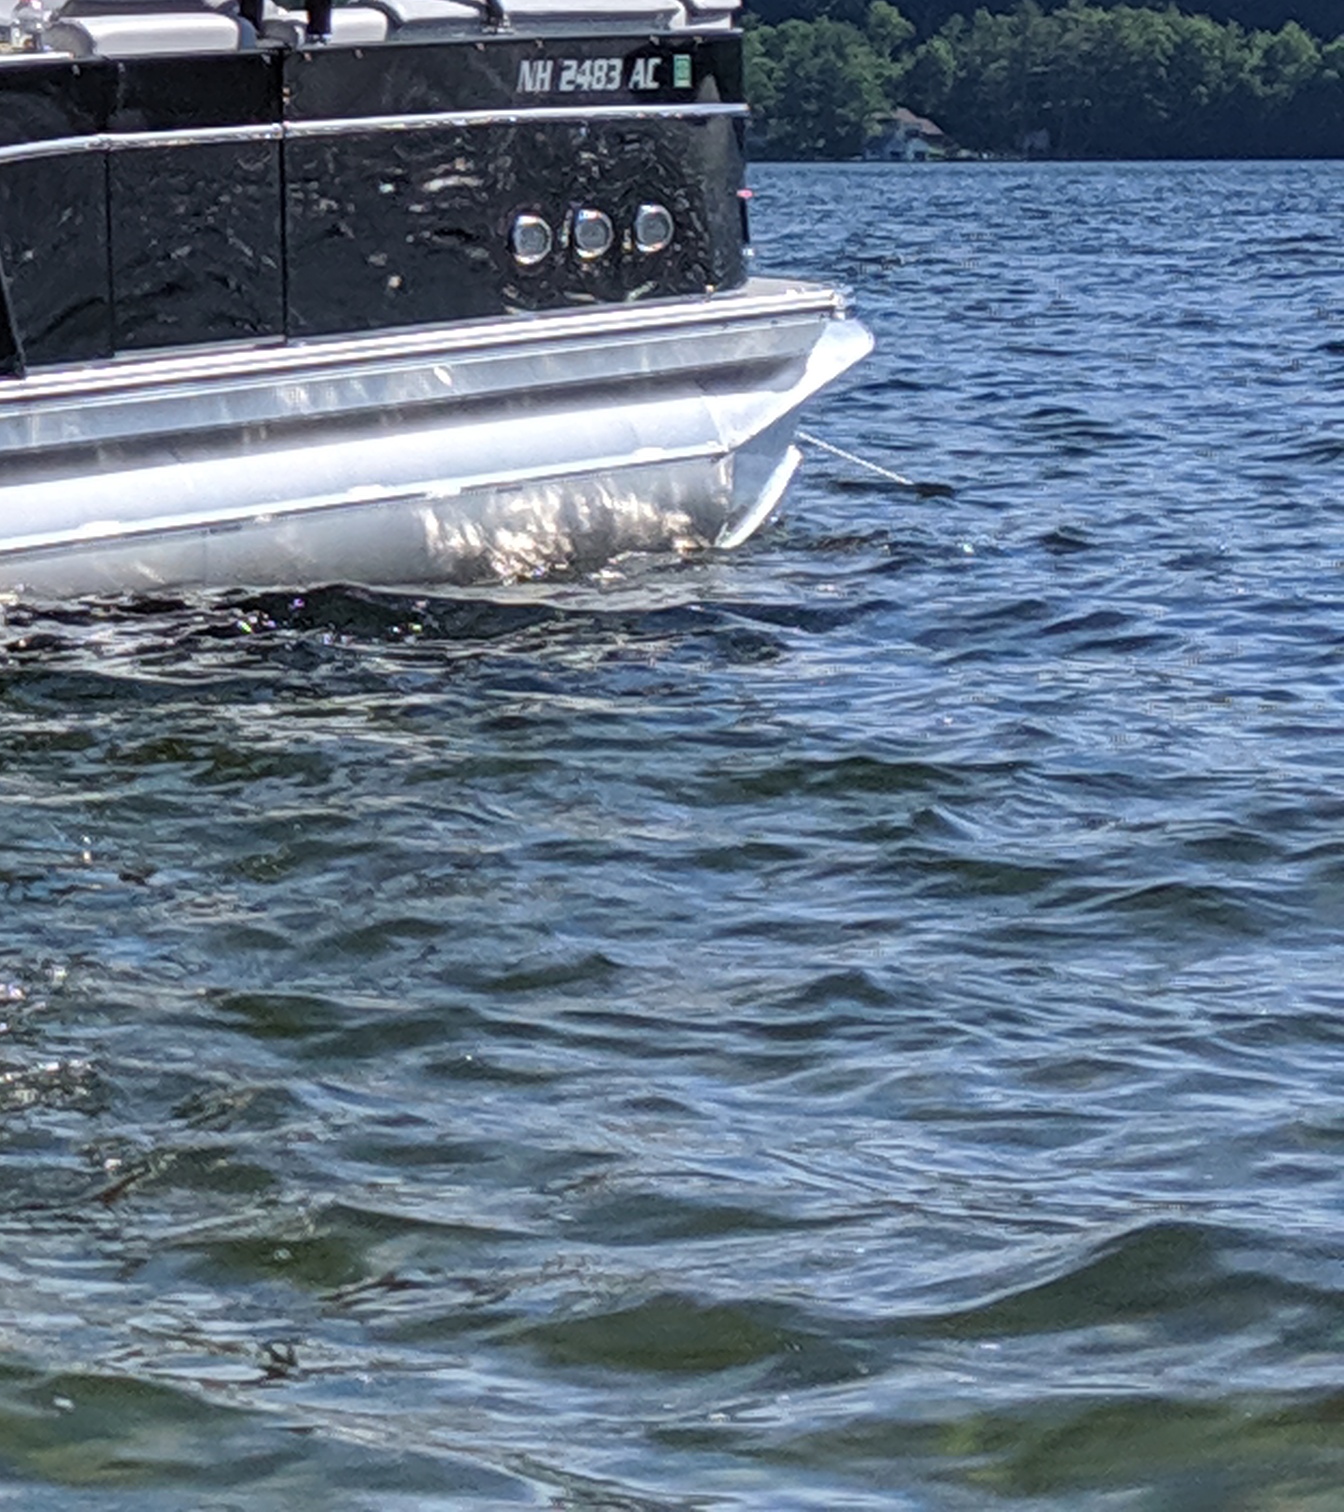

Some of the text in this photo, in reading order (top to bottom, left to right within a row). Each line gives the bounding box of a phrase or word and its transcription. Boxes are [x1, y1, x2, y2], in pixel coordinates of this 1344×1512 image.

[518, 60, 553, 92] NH
[559, 58, 624, 92] 2483
[629, 57, 662, 89] AC
